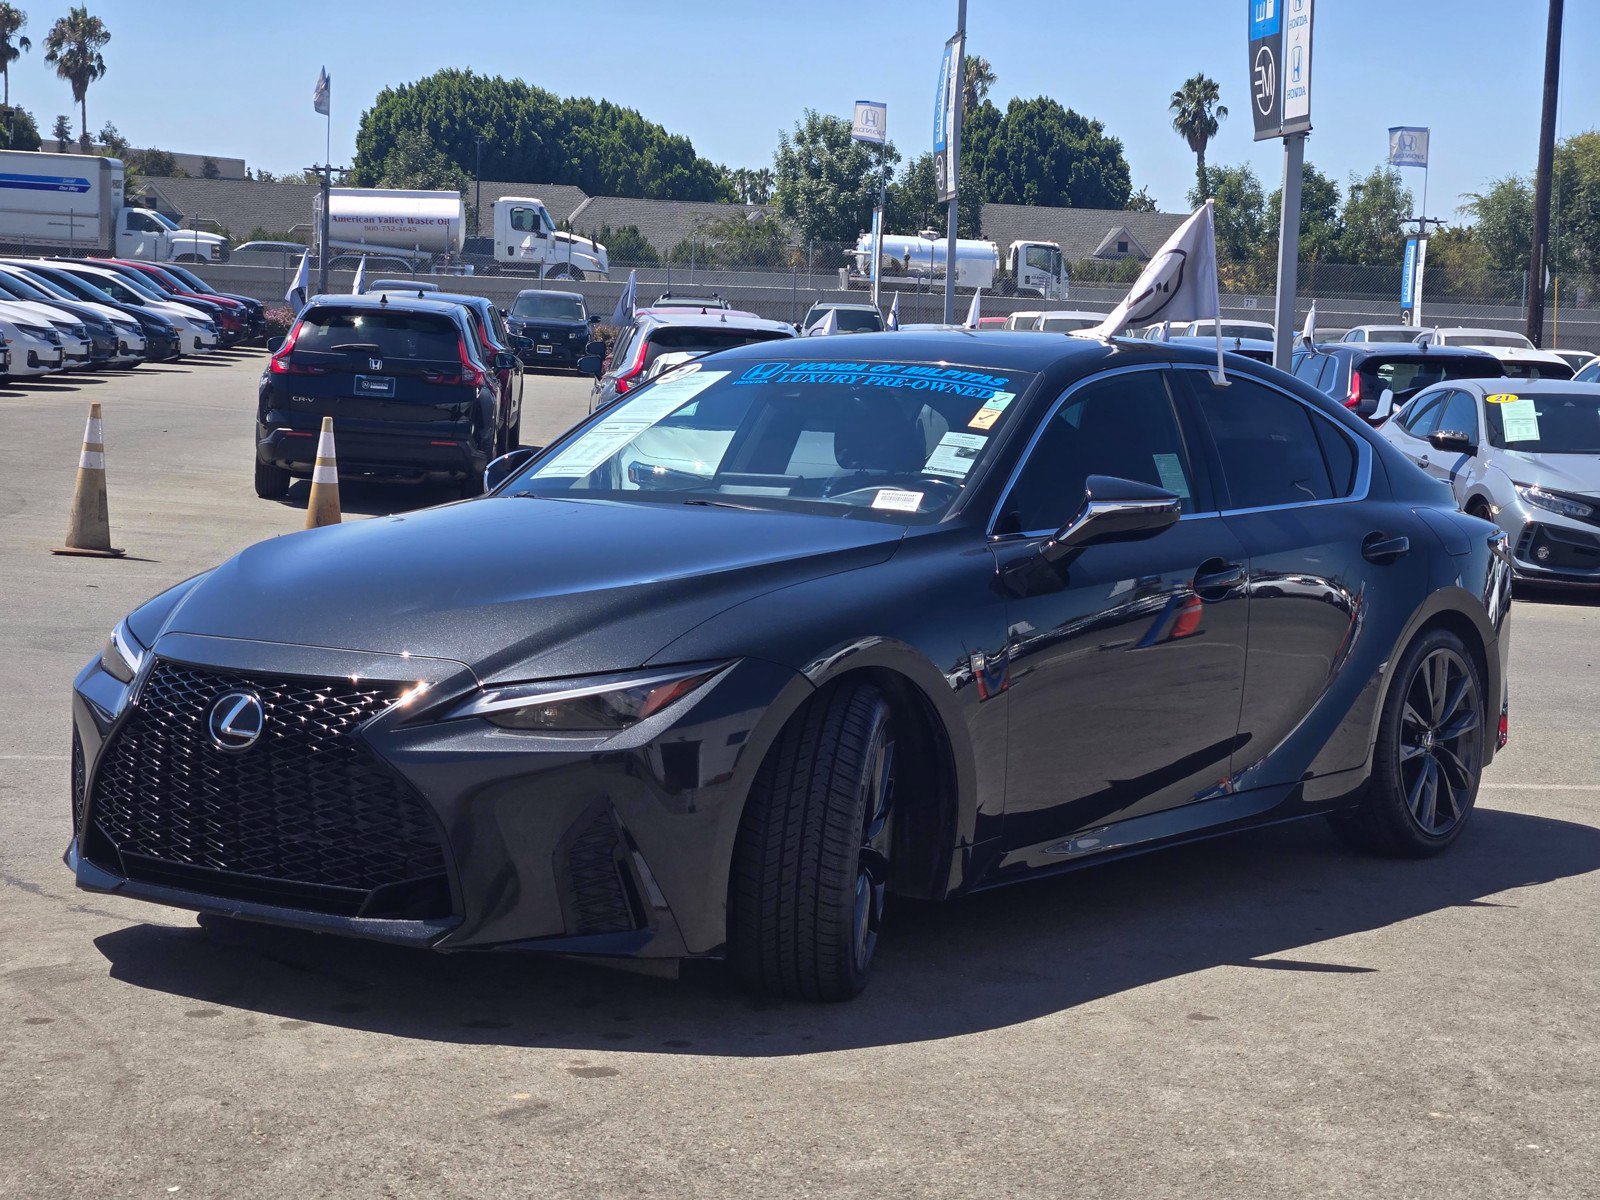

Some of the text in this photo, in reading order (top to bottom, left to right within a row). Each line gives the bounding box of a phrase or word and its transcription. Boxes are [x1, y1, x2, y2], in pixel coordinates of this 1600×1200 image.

[1288, 14, 1308, 30] HONDA
[1287, 86, 1307, 100] HONDA
[332, 215, 451, 226] American Valley Waste Oil
[790, 362, 1010, 386] HONDA OF MILPITAS
[775, 373, 867, 384] LUXURY
[862, 375, 995, 399] PRE-OWNED
[292, 395, 315, 403] CR-V
